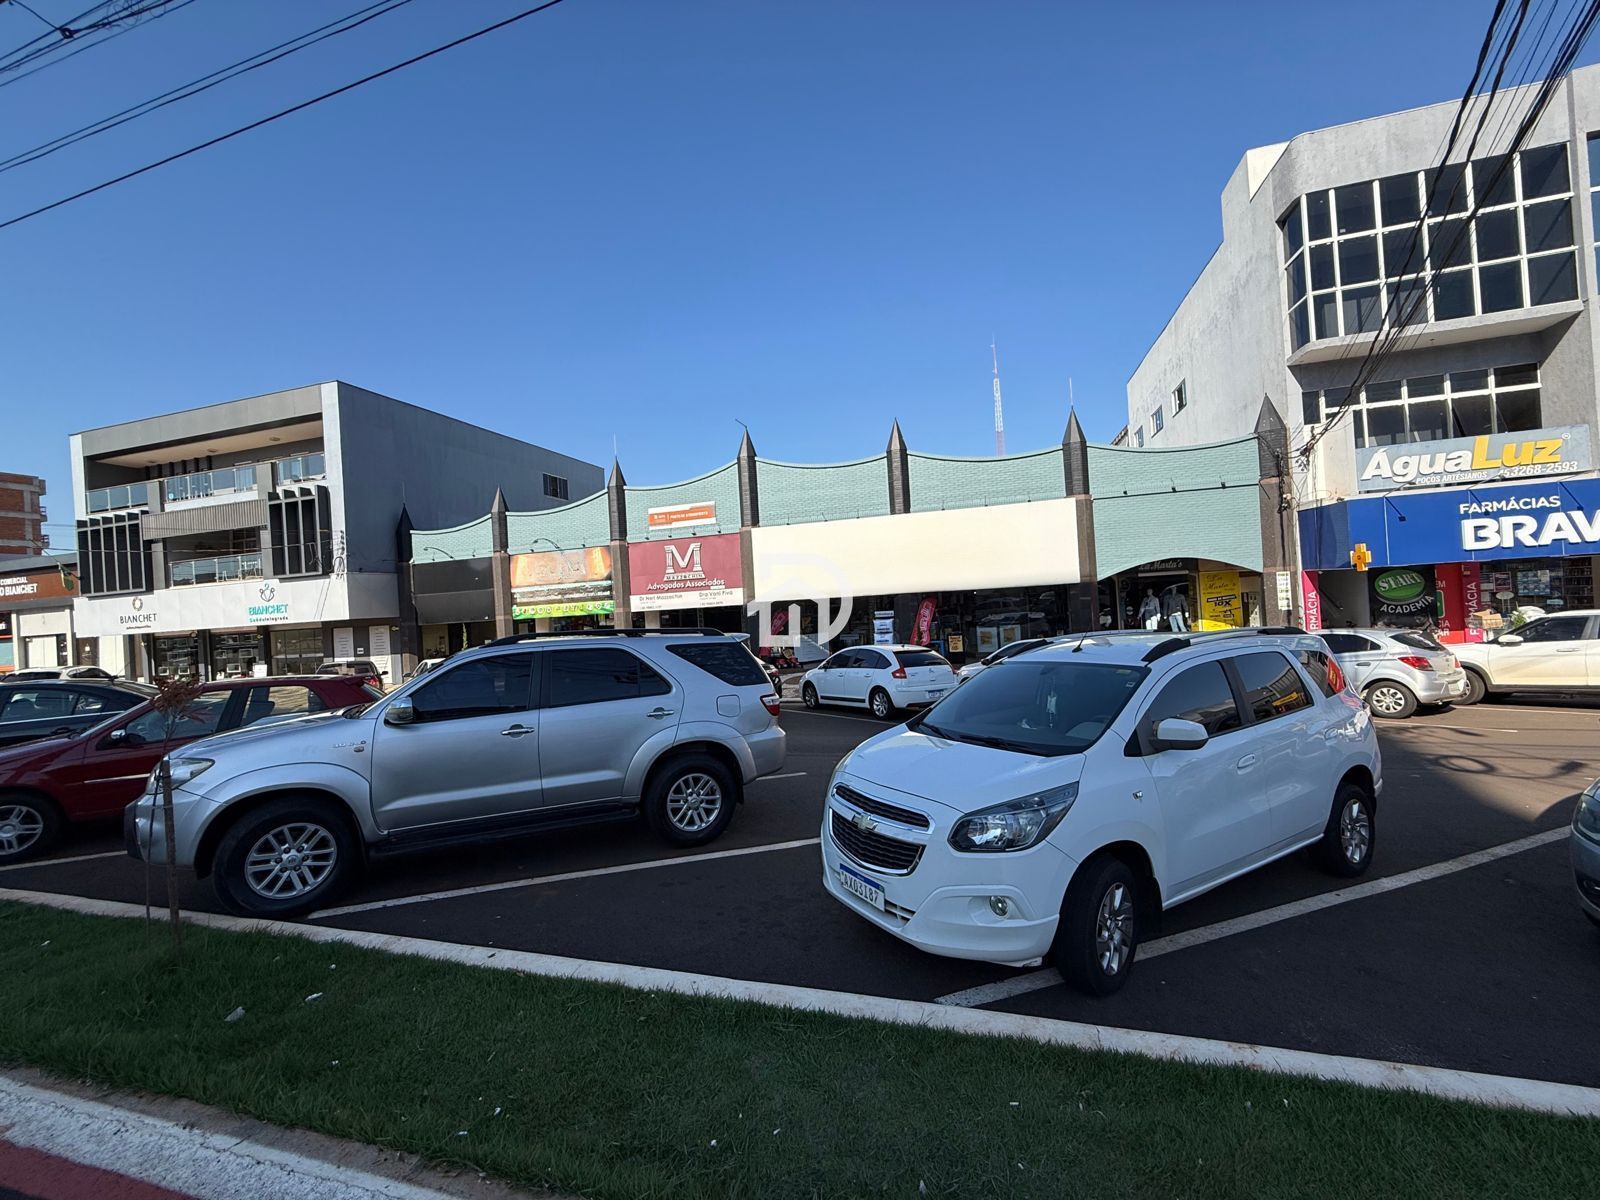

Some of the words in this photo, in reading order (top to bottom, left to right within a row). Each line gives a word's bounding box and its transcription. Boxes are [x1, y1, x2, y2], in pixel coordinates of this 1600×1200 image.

[1360, 434, 1563, 483] ÁguaLuz
[1416, 475, 1441, 484] POÇOS
[1443, 471, 1488, 482] ARTESIANOS
[1459, 495, 1561, 514] FARMÁCIAS
[1461, 509, 1600, 551] BRAV
[5, 583, 38, 596] BIANCHET
[647, 582, 685, 591] Advogados
[686, 579, 725, 588] Associados
[1379, 573, 1422, 591] START
[248, 603, 288, 616] BIANCHET
[1307, 591, 1319, 630] RMÁCIA
[1380, 595, 1434, 614] ACADEMIA
[119, 613, 157, 624] BIANCHET
